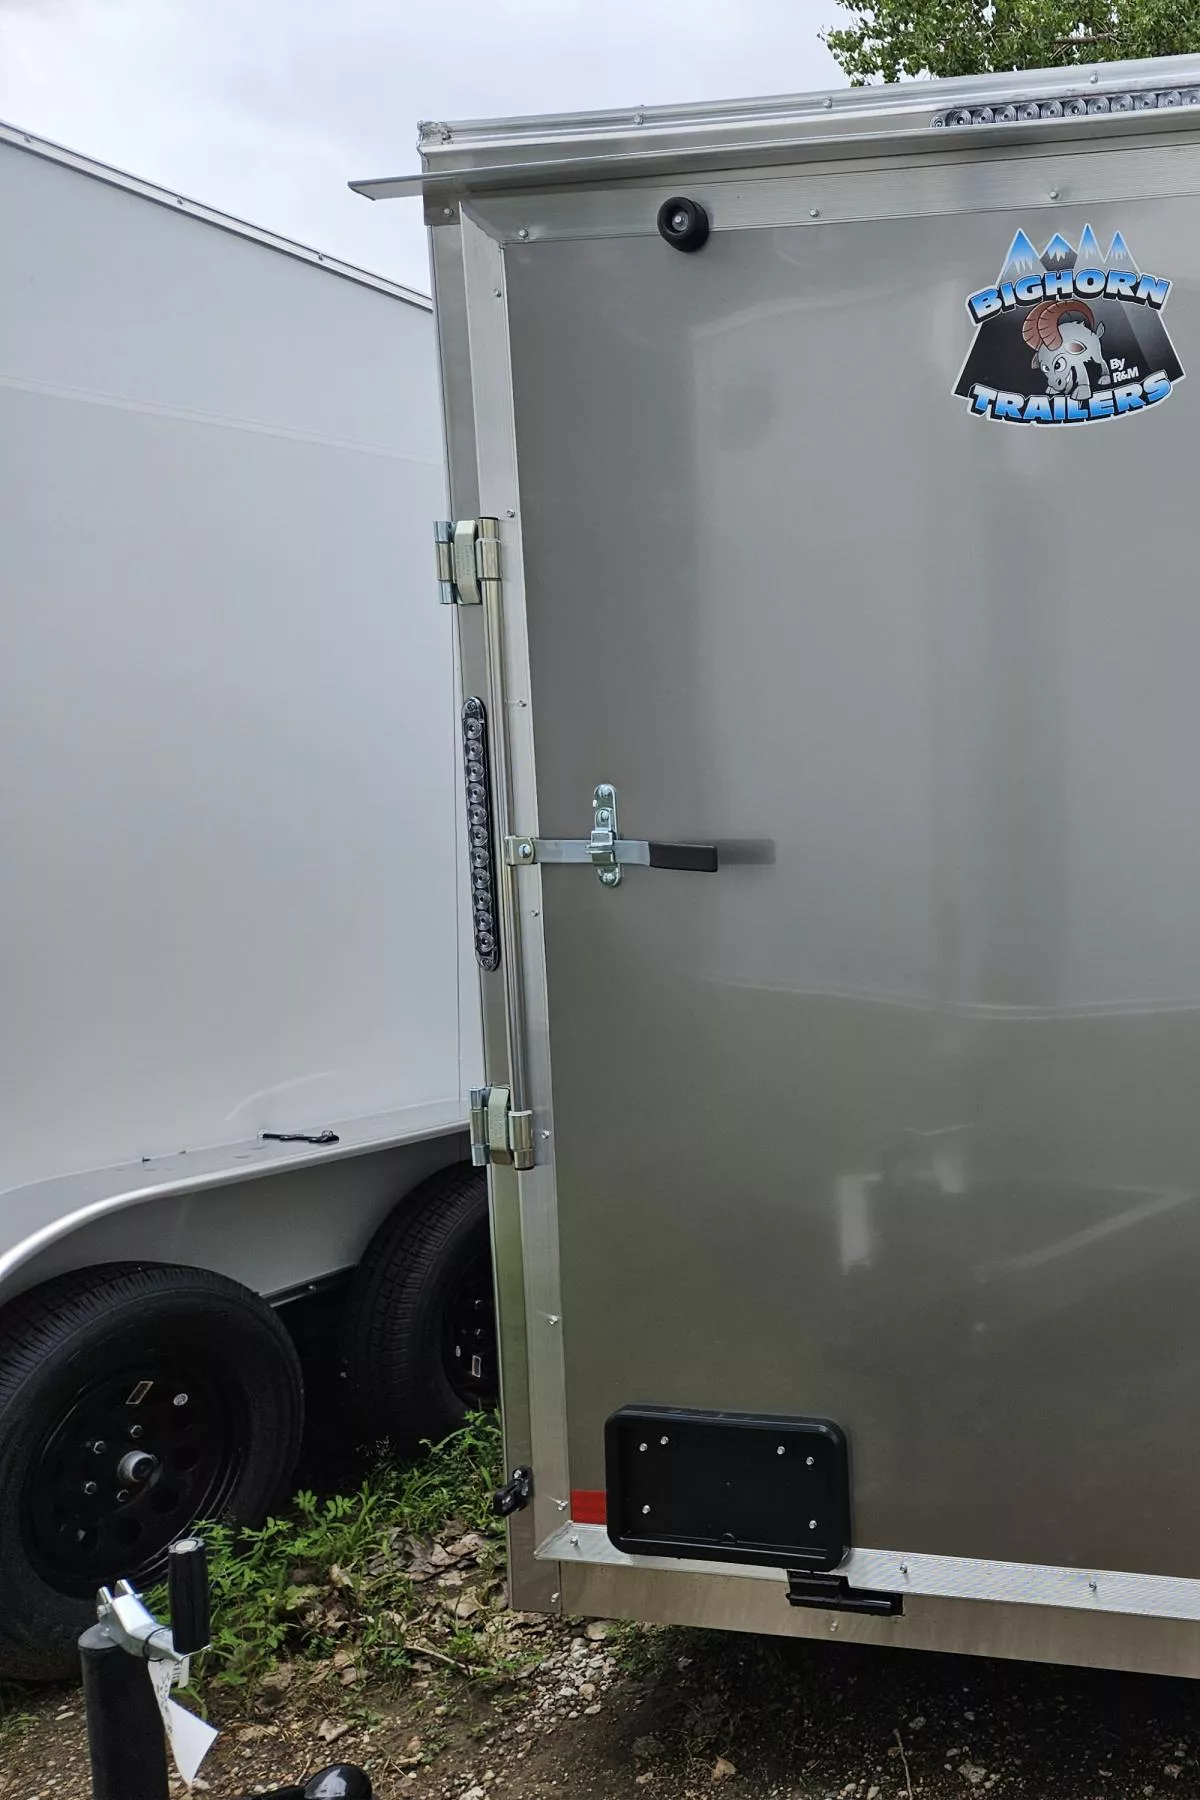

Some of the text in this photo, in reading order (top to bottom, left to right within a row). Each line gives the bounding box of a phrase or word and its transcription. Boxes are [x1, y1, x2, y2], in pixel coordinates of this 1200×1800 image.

[968, 268, 1171, 323] BIGHORN
[1109, 357, 1126, 370] By
[1112, 366, 1140, 382] R&M
[969, 370, 1172, 422] TRAILERS
